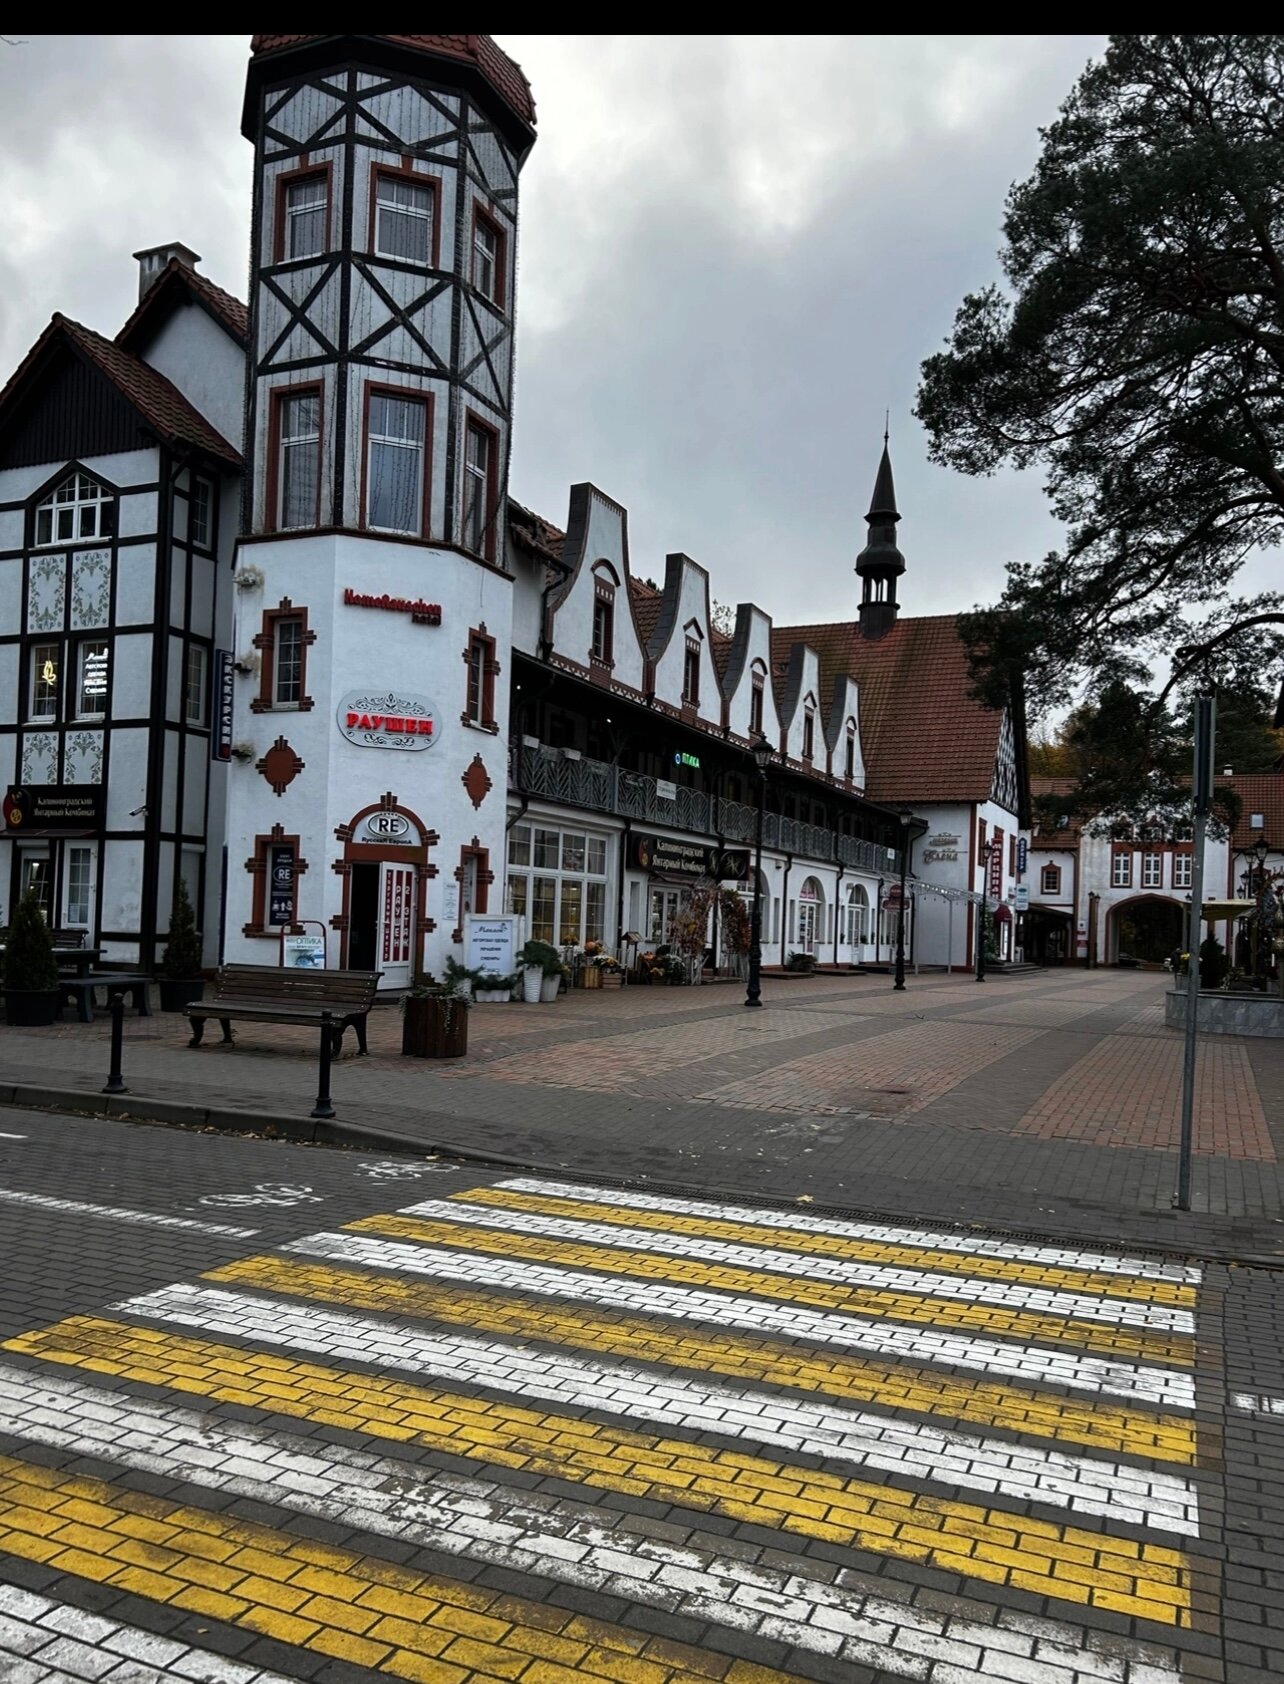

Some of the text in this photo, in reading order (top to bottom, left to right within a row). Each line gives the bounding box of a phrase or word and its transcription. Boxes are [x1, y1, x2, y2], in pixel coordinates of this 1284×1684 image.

[221, 655, 233, 745] ЭКСКУРСИИ
[346, 712, 433, 736] РАУШЕН
[379, 818, 399, 833] RE
[278, 868, 291, 880] RE
[406, 885, 411, 895] 2
[394, 885, 402, 948] РАУШЕН
